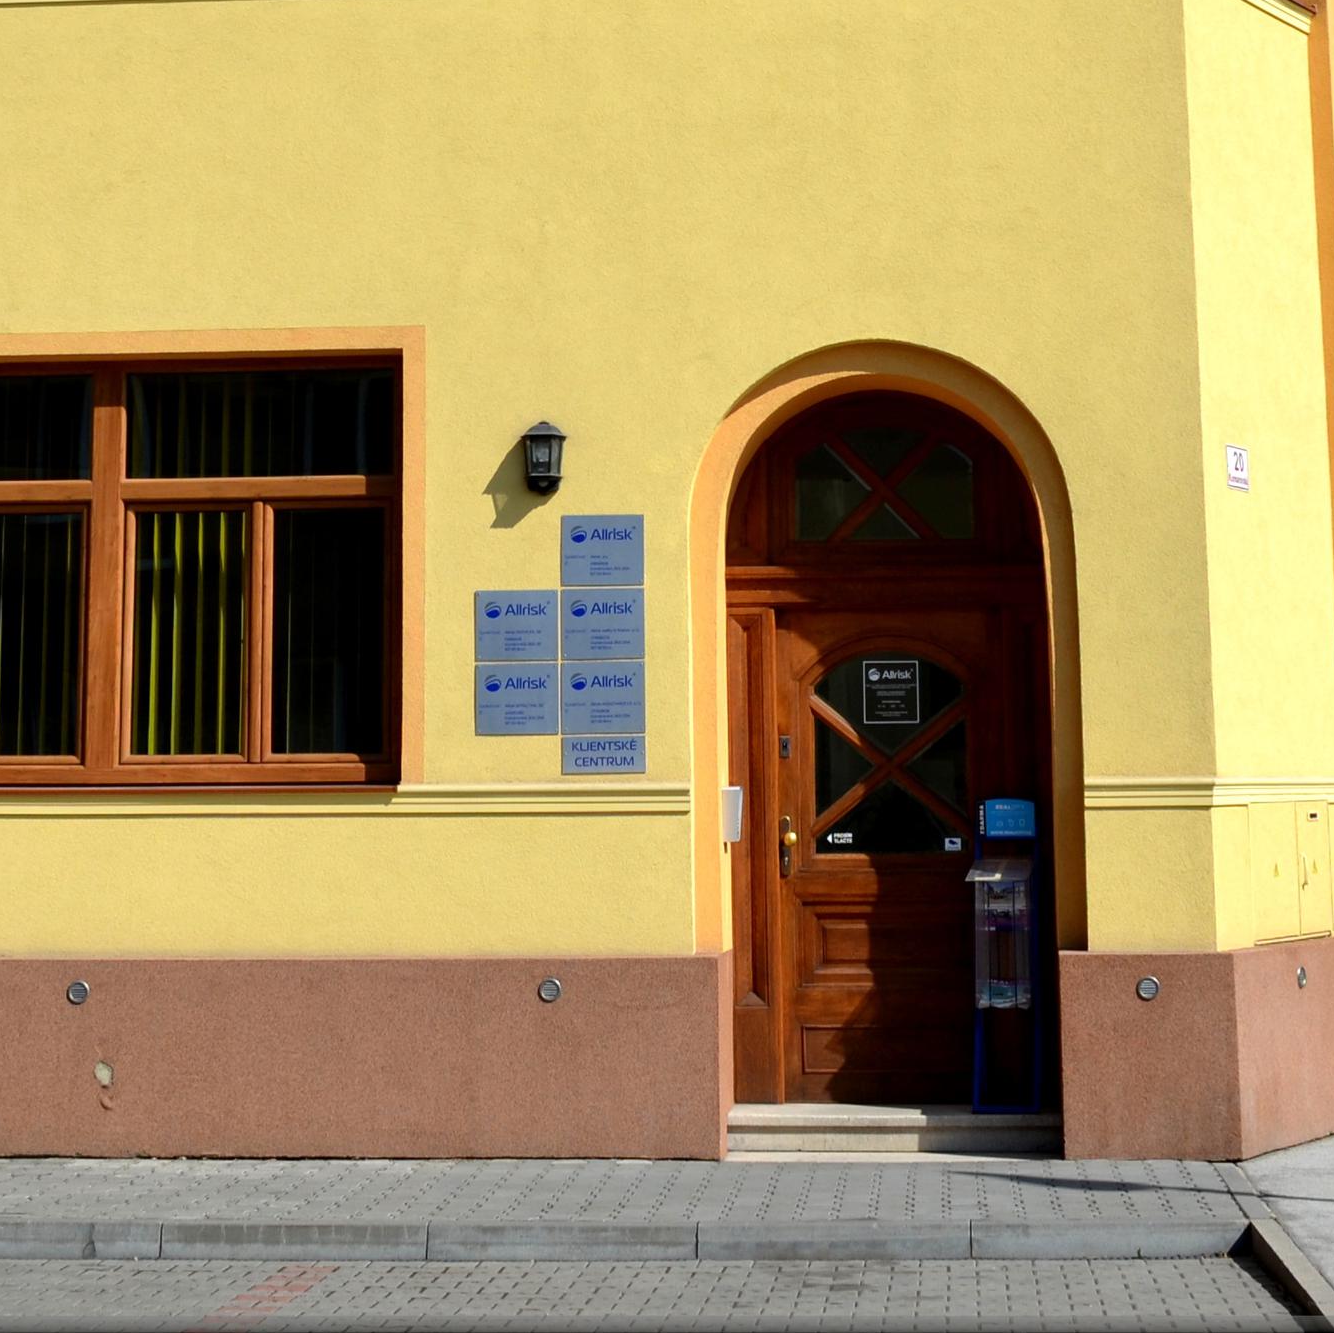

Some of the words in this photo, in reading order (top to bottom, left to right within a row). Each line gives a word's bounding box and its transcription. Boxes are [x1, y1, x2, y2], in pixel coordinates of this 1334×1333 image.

[1233, 451, 1244, 472] 20
[590, 528, 633, 540] Allrisk
[505, 603, 547, 616] Allrisk
[590, 602, 633, 614] Allrisk
[882, 669, 912, 679] Allrisk
[505, 676, 547, 689] Allrisk
[590, 675, 633, 688] Allrisk
[571, 738, 637, 752] KLIENTSKÉ
[574, 756, 635, 767] CENTRUM
